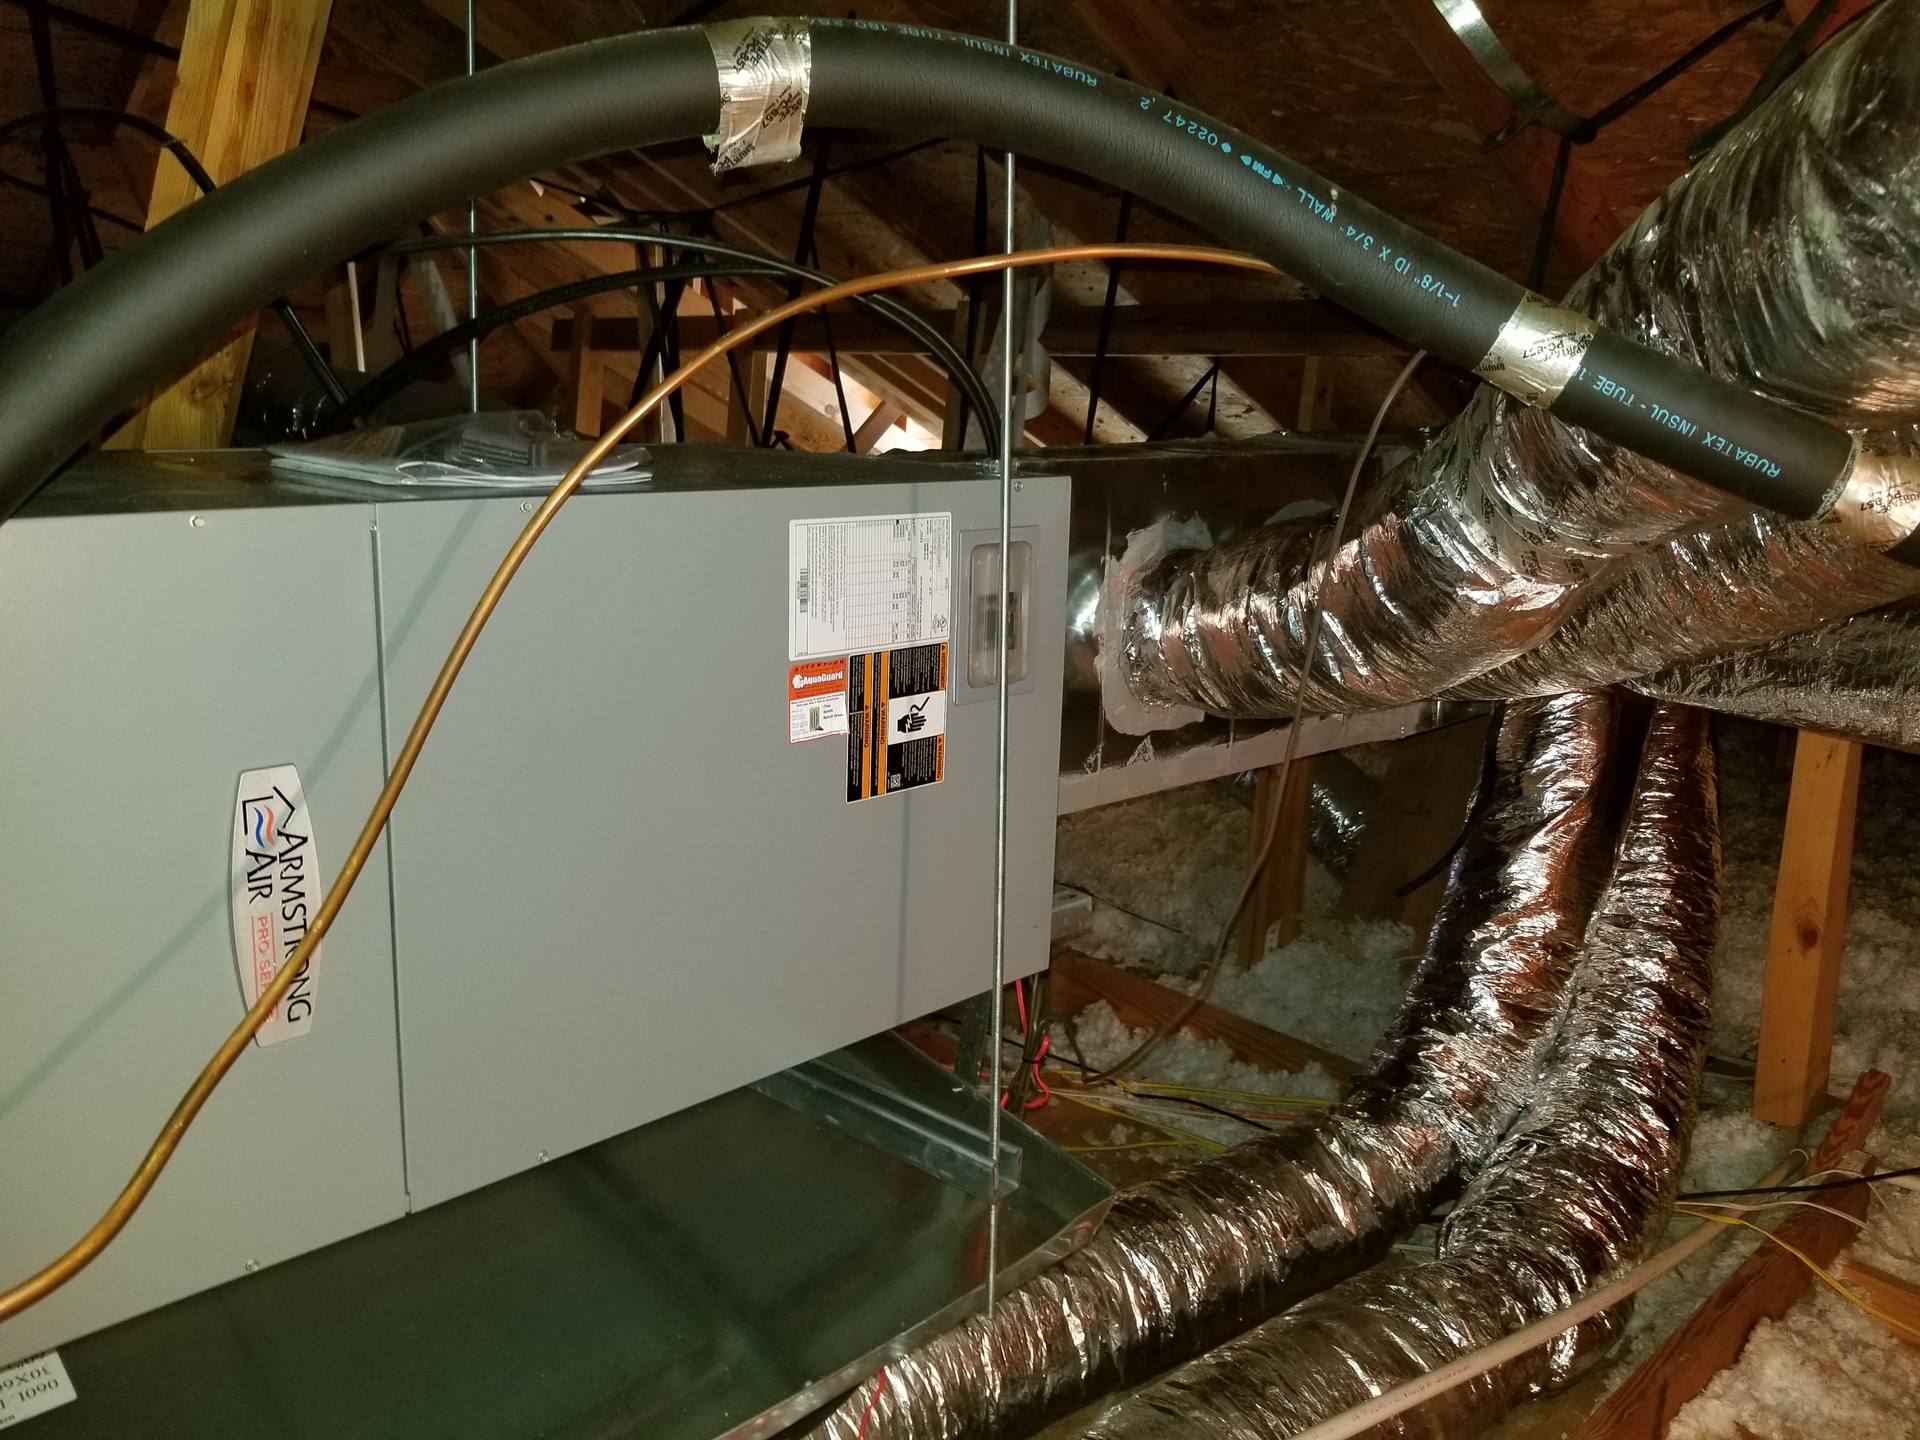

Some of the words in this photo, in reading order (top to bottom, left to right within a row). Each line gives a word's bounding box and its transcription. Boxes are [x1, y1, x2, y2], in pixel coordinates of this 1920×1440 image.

[964, 36, 1011, 57] INSUL
[1020, 51, 1098, 88] RUBATEX
[1162, 109, 1218, 147] 02247
[1298, 187, 1337, 223] WALL
[1340, 225, 1374, 250] 3/4"
[1378, 246, 1392, 261] X
[1394, 257, 1411, 274] ID
[1414, 273, 1461, 308] 1-1/8"
[1593, 375, 1635, 408] TUBE
[1650, 404, 1697, 438] INSUL
[1702, 431, 1781, 479] RUBATEX
[803, 671, 843, 686] AquaGuard
[246, 848, 277, 905] AIR
[257, 915, 270, 953] PRO
